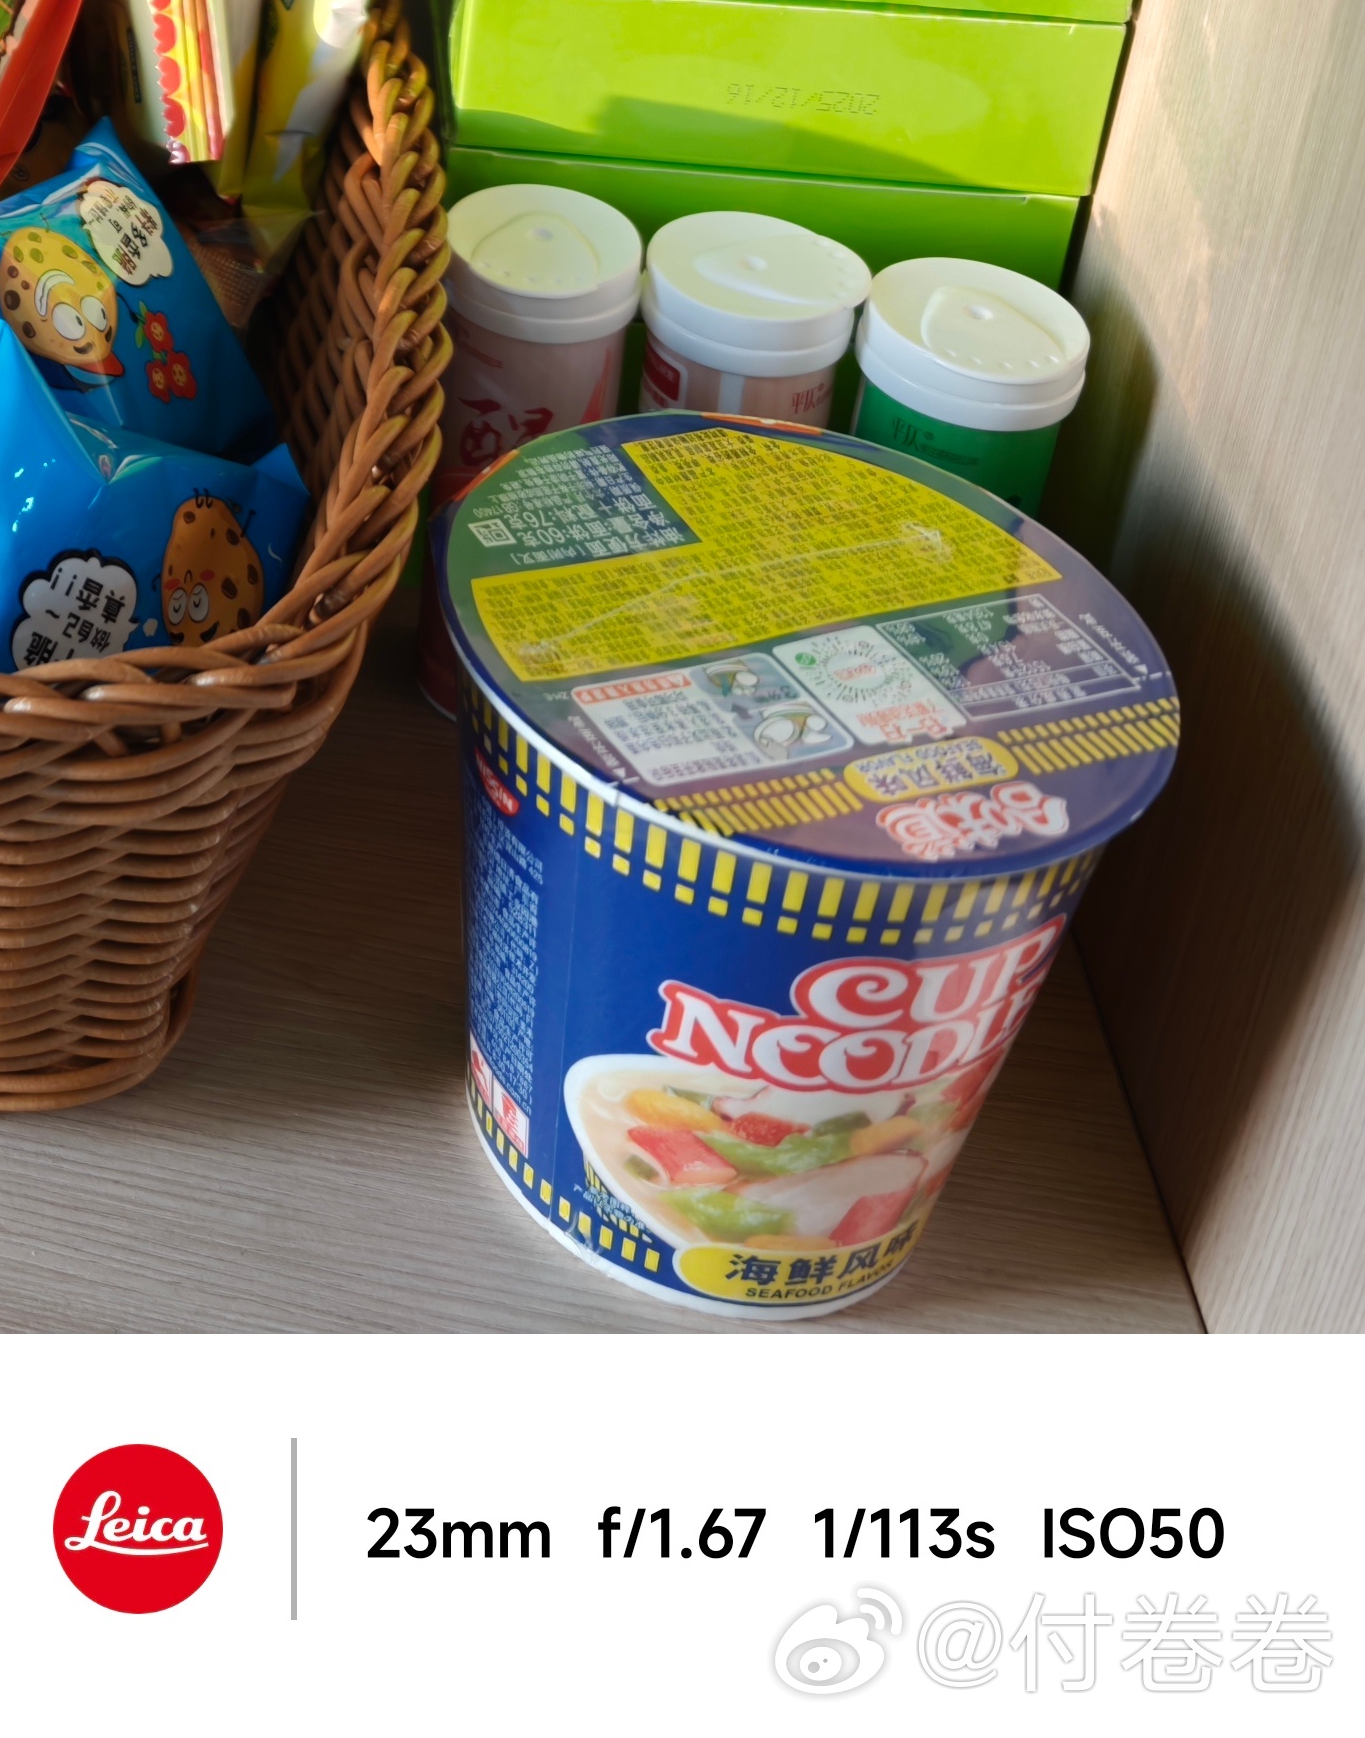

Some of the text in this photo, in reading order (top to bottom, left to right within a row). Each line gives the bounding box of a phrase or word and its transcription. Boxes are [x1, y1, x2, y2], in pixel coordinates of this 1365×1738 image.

[108, 206, 161, 275] 料多香脆
[586, 527, 684, 555] 油炸方便面
[49, 565, 127, 623] 真香!!
[865, 753, 1007, 799] 海鲜风味
[877, 780, 1069, 862] 合味道
[808, 919, 1064, 1029] CUP
[663, 987, 1040, 1088] NOODLE
[725, 1221, 917, 1286] 海鲜风味
[745, 1283, 833, 1299] SEAFOOD
